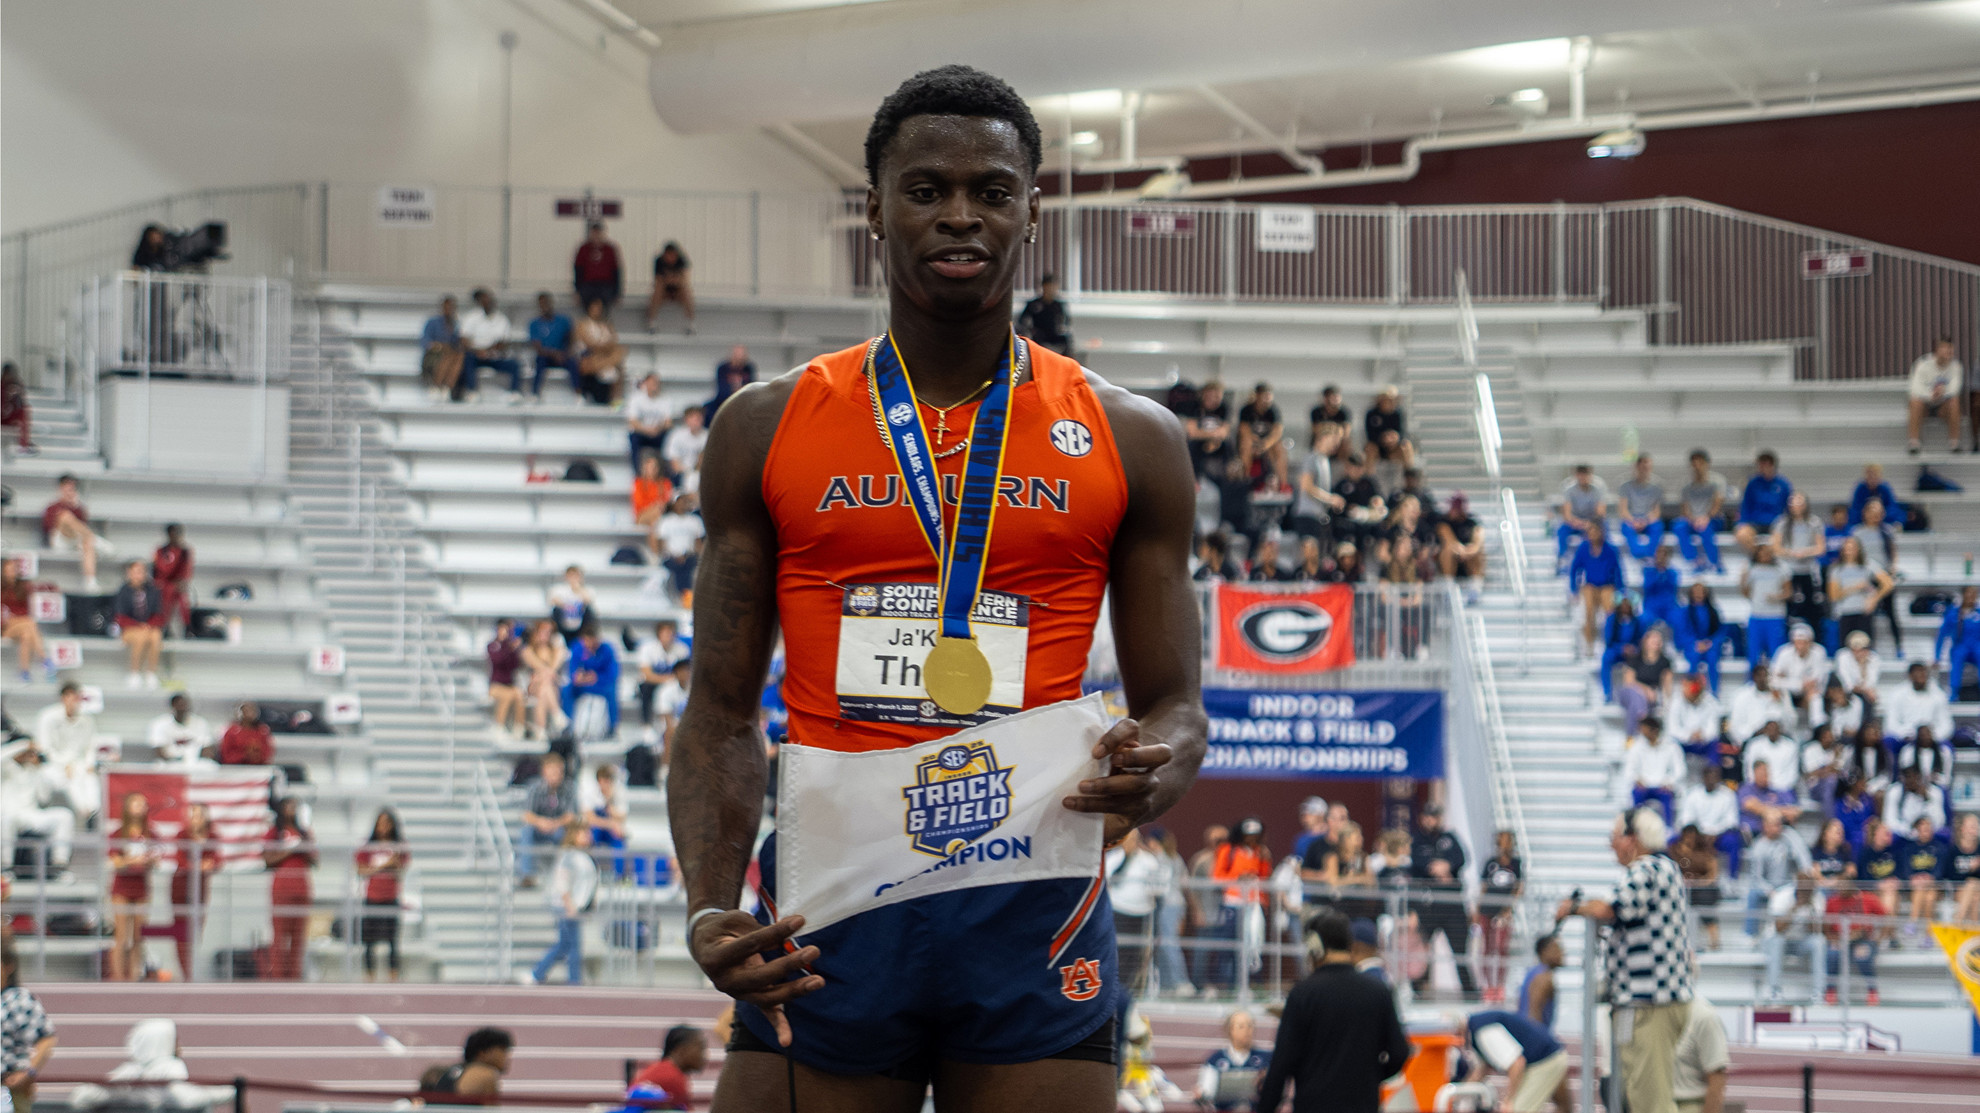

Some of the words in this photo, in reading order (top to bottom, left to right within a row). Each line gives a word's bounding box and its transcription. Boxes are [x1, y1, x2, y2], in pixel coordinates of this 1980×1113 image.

[1050, 420, 1093, 456] SEC
[902, 432, 925, 477] SCHOLARS,
[916, 475, 941, 526] CHAMPIONS,
[816, 474, 1070, 513] AUURN
[881, 597, 1018, 619] CONFNCE
[882, 585, 1018, 608] SOUTHTERN
[1250, 694, 1355, 719] INDOOR
[1208, 717, 1293, 743] TRACK
[1293, 719, 1316, 744] &
[1318, 720, 1396, 745] FIELD
[942, 750, 967, 767] SEC
[907, 771, 1007, 809] TRACK
[909, 809, 927, 832] &
[933, 797, 1007, 828] FIELD
[925, 823, 989, 838] CHAMPIONSHIPS
